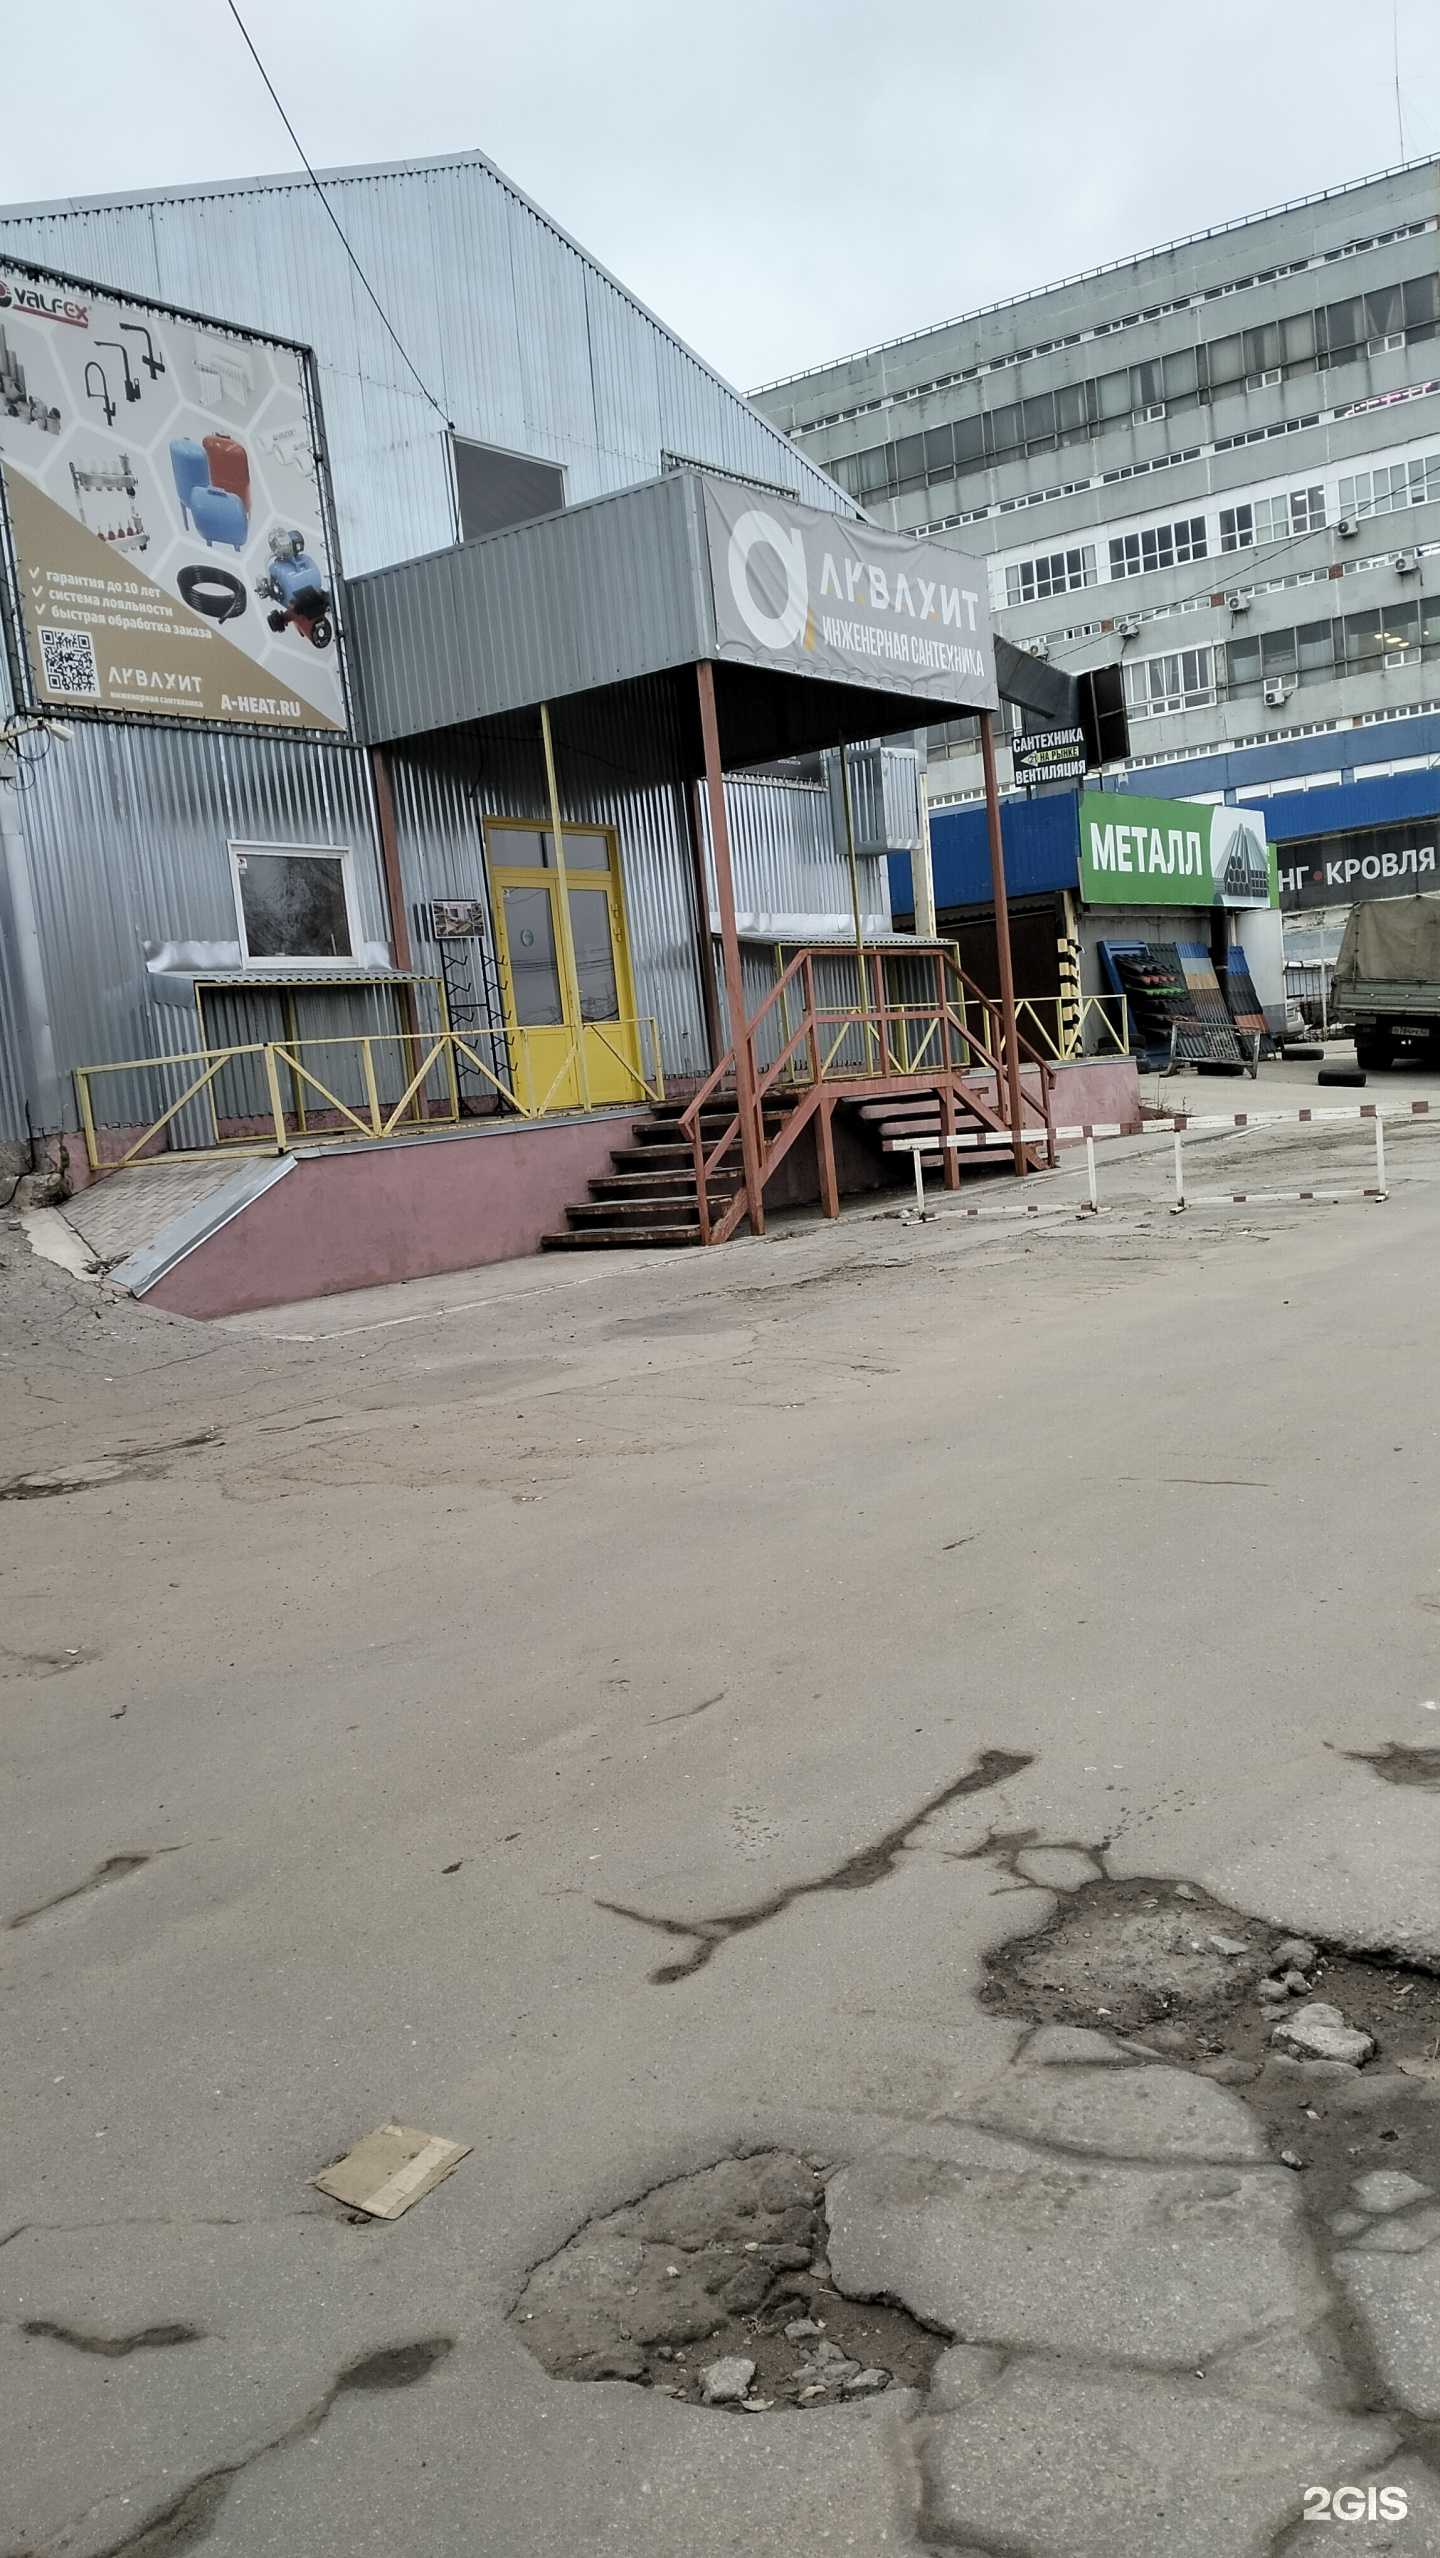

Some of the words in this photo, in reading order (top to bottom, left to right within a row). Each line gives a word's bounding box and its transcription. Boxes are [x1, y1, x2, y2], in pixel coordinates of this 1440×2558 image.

[46, 571, 105, 589] гарантия
[107, 582, 122, 594] до
[124, 582, 138, 595] 10
[141, 586, 161, 598] лет
[49, 589, 100, 607] система
[102, 597, 173, 617] лояльности
[51, 605, 106, 624] быстрая
[108, 614, 171, 633] обработка
[173, 625, 212, 639] заказа
[822, 615, 909, 662] ИНЖЕНЕРНАЯ
[911, 636, 985, 677] САНТЕХНИКА
[221, 694, 301, 717] A-HEAT.RU
[1013, 728, 1084, 753] САНТЕХНИКА
[1039, 752, 1050, 762] НА
[1052, 747, 1077, 760] РЫНКЕ
[1016, 760, 1086, 785] ВЕНТИЛЯЦИЯ
[1090, 822, 1202, 876] МЕТАЛЛ
[1326, 846, 1436, 885] КРОВЛЯ
